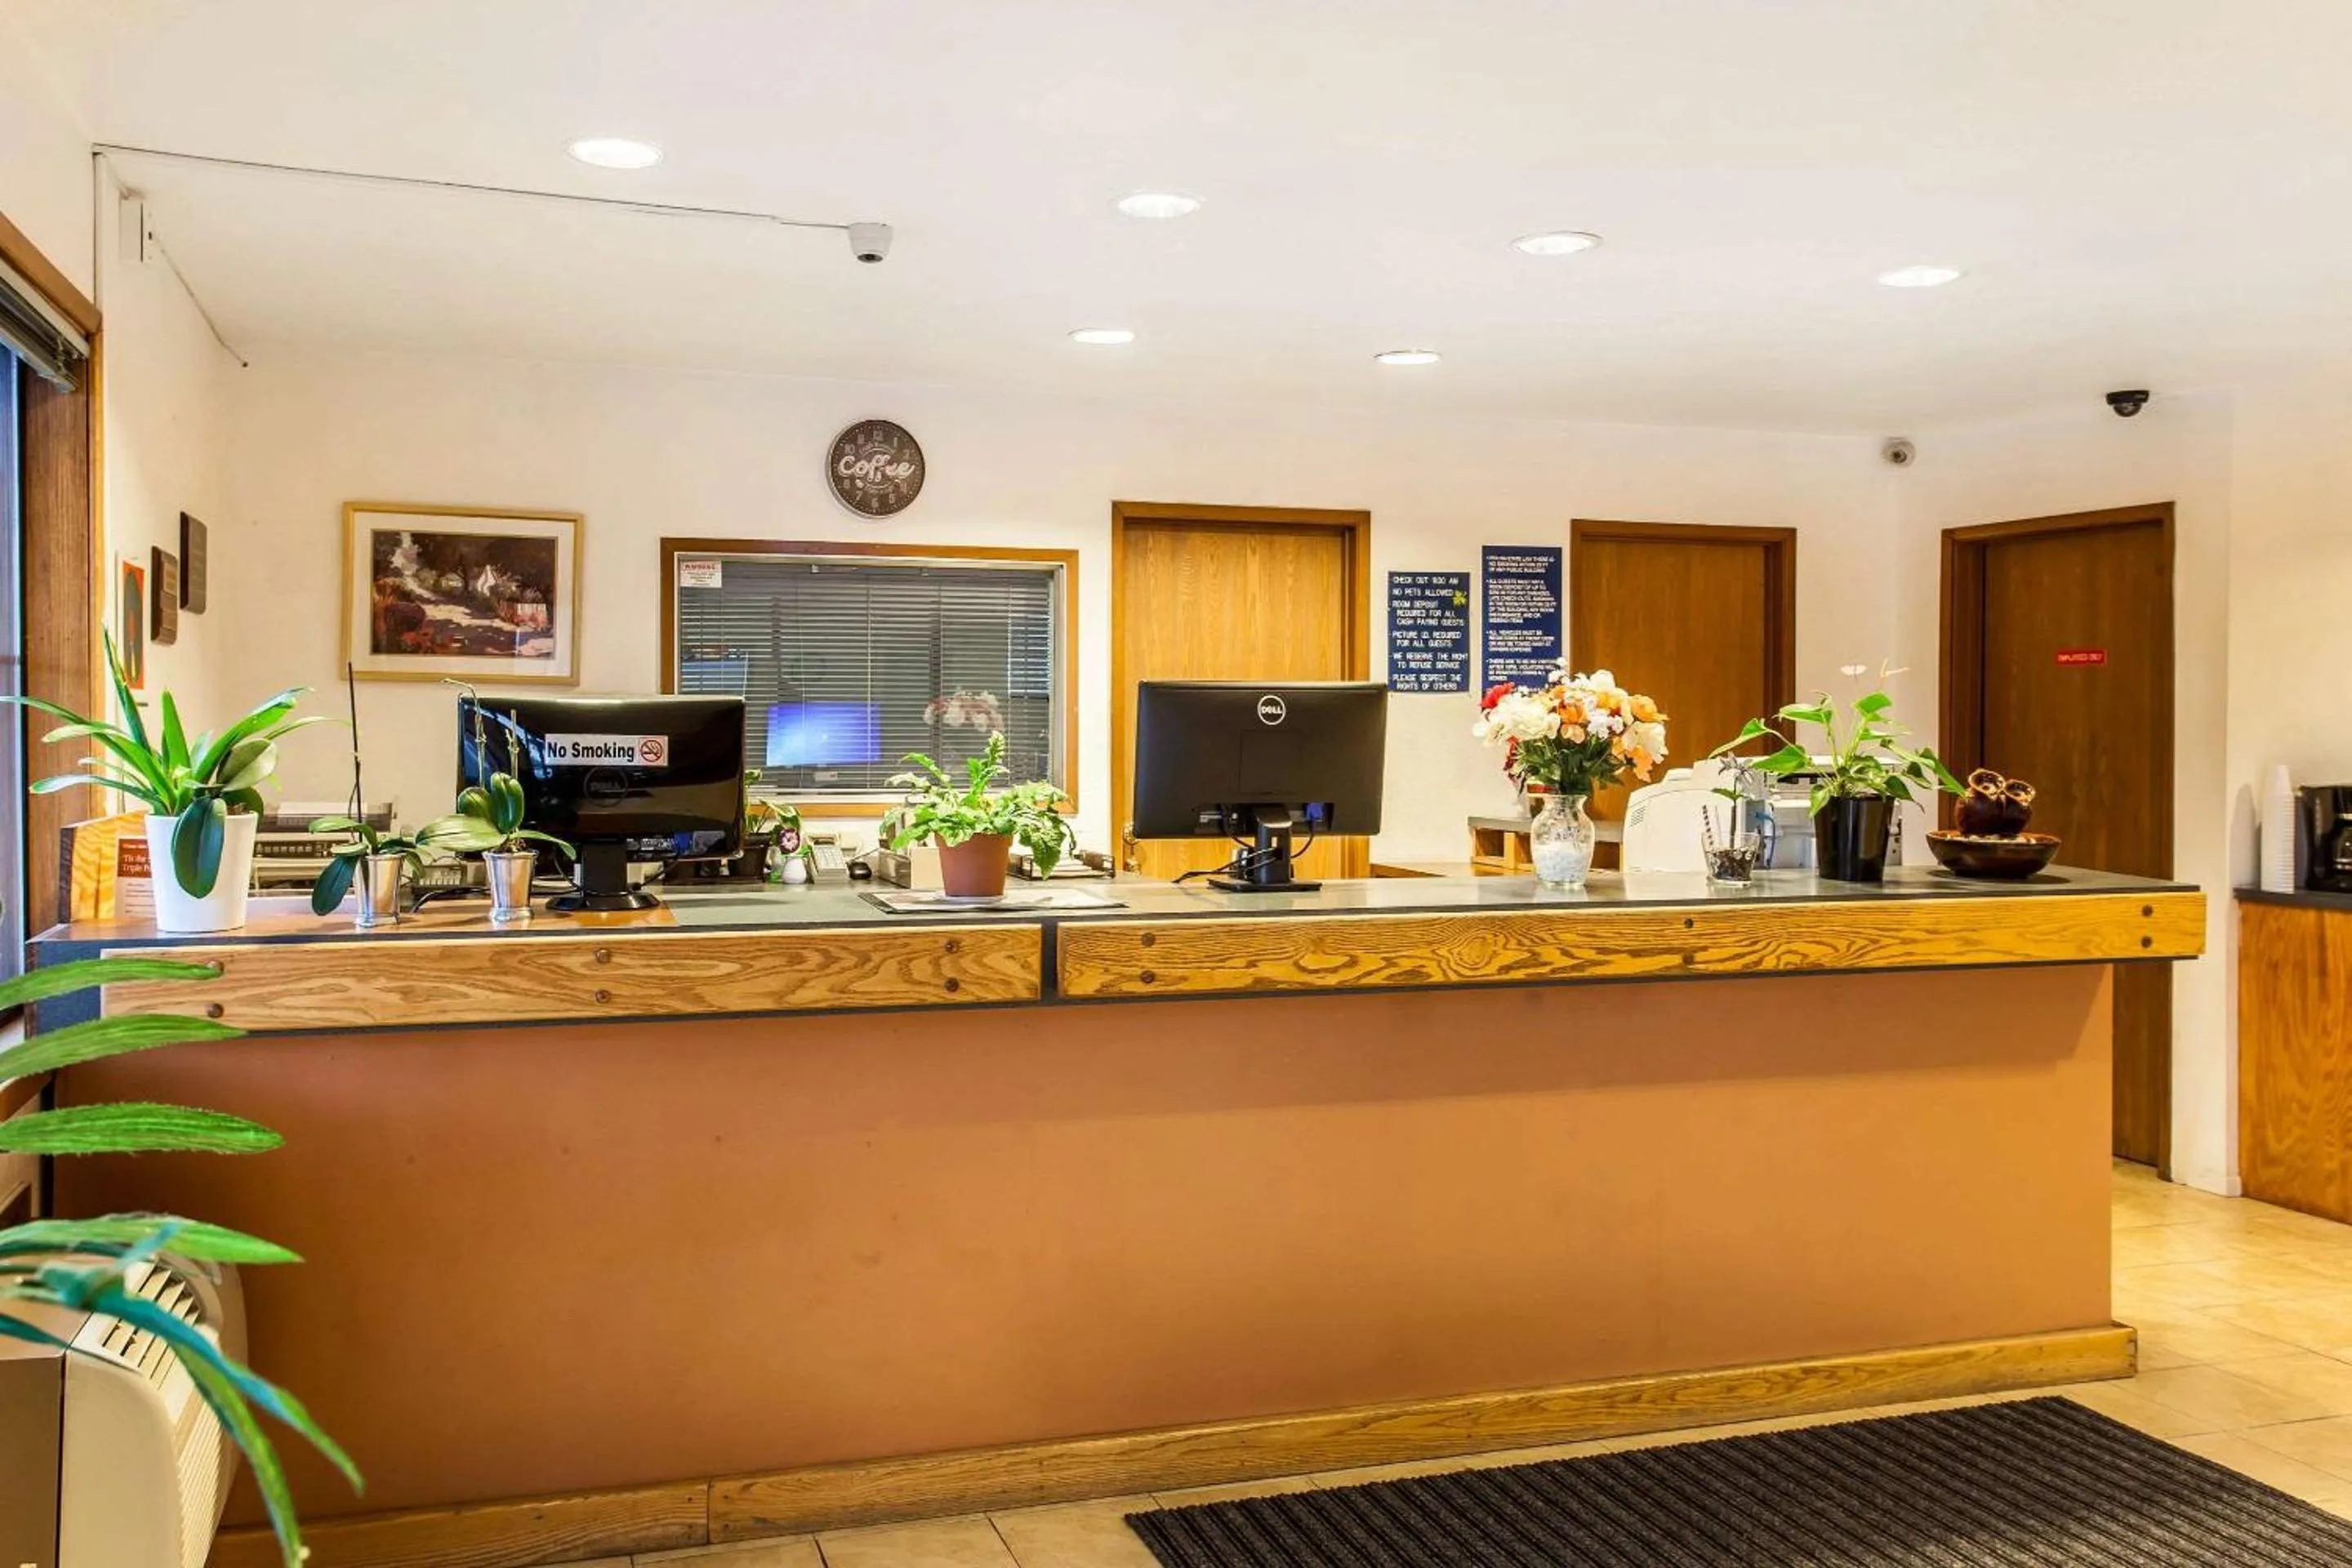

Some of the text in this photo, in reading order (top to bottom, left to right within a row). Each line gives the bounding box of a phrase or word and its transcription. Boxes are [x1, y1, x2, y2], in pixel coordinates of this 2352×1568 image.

[837, 455, 915, 483] Coffee
[1393, 576, 1413, 584] CHECK
[1415, 576, 1428, 584] OUT
[1449, 577, 1459, 585] AM
[1405, 587, 1421, 596] PETS
[1424, 588, 1454, 596] ALLOWED
[1392, 599, 1438, 608] ROOM DEPOSIT
[1396, 609, 1455, 617] REQUIRED FOR ALL
[1396, 617, 1463, 626] CASH PAYING GUESTS
[1392, 630, 1418, 639] PICTURE
[1432, 630, 1462, 639] REQUIRED
[1396, 639, 1452, 648] FOR ALL GUESTS
[1393, 652, 1468, 661] WE RESERVE THE RIGHT
[1436, 661, 1460, 669] SERVICE
[1450, 674, 1462, 682] THE
[1396, 682, 1457, 690] RIGHTS OF OTHERS
[1261, 705, 1283, 714] DELL
[548, 741, 635, 762] No Smoking
